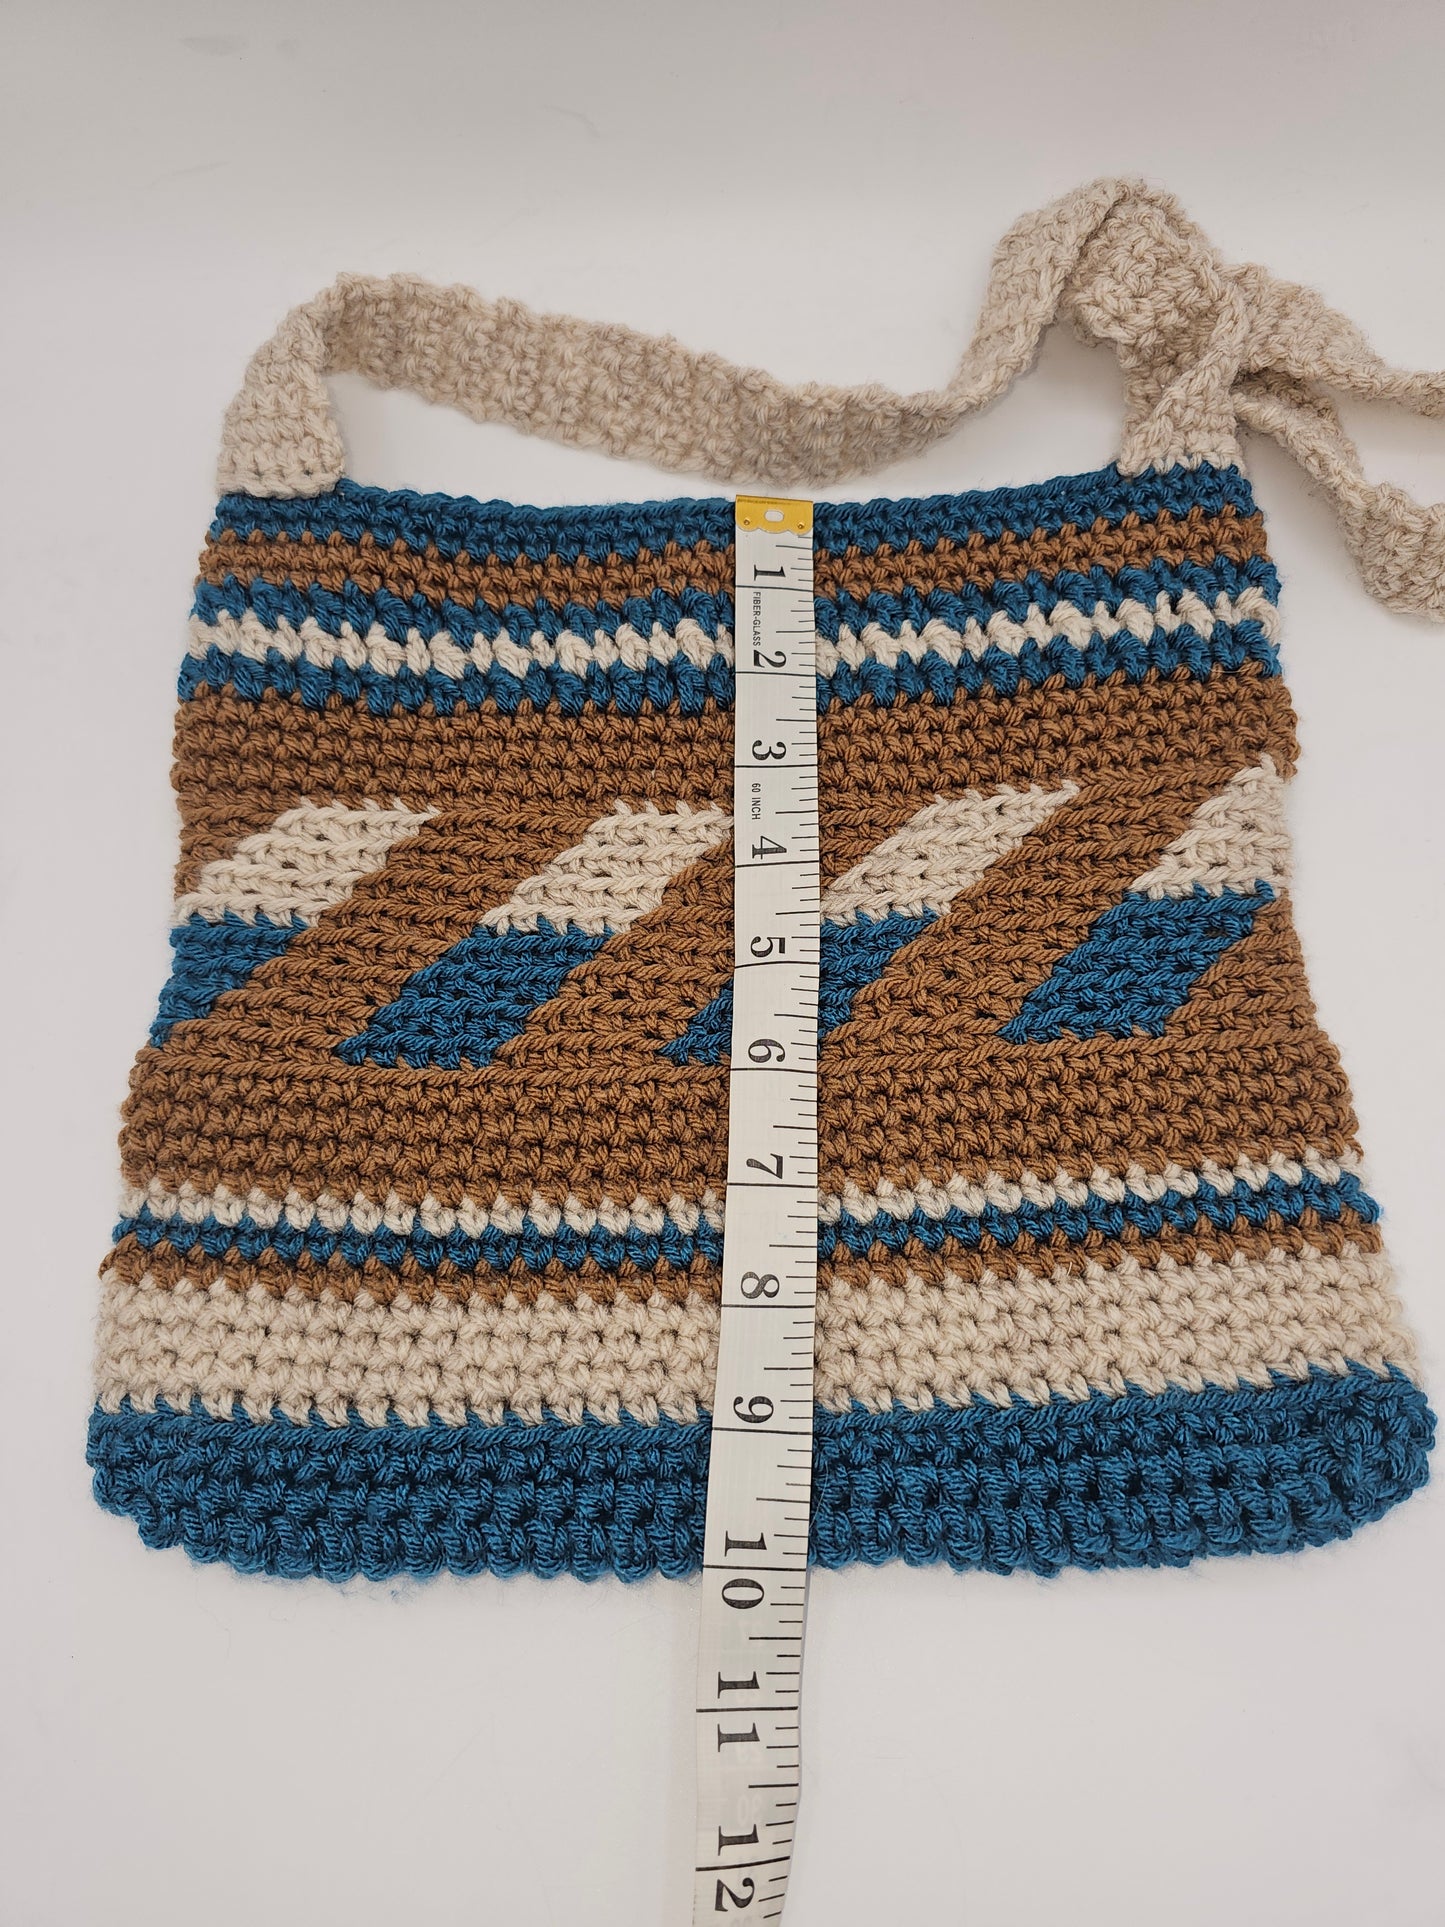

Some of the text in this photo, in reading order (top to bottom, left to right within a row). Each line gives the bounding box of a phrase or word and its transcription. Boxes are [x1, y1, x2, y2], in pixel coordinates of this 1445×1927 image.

[754, 564, 786, 581] 1
[753, 591, 761, 646] FIBER-GLASS
[753, 650, 787, 668] 2
[752, 740, 787, 761] 3
[752, 782, 761, 820] 60 INCH
[752, 835, 787, 859] 4
[751, 936, 785, 958] 5
[748, 1038, 785, 1063] 6
[746, 1153, 783, 1179] 7
[741, 1271, 780, 1298] 8
[733, 1396, 774, 1423] 9
